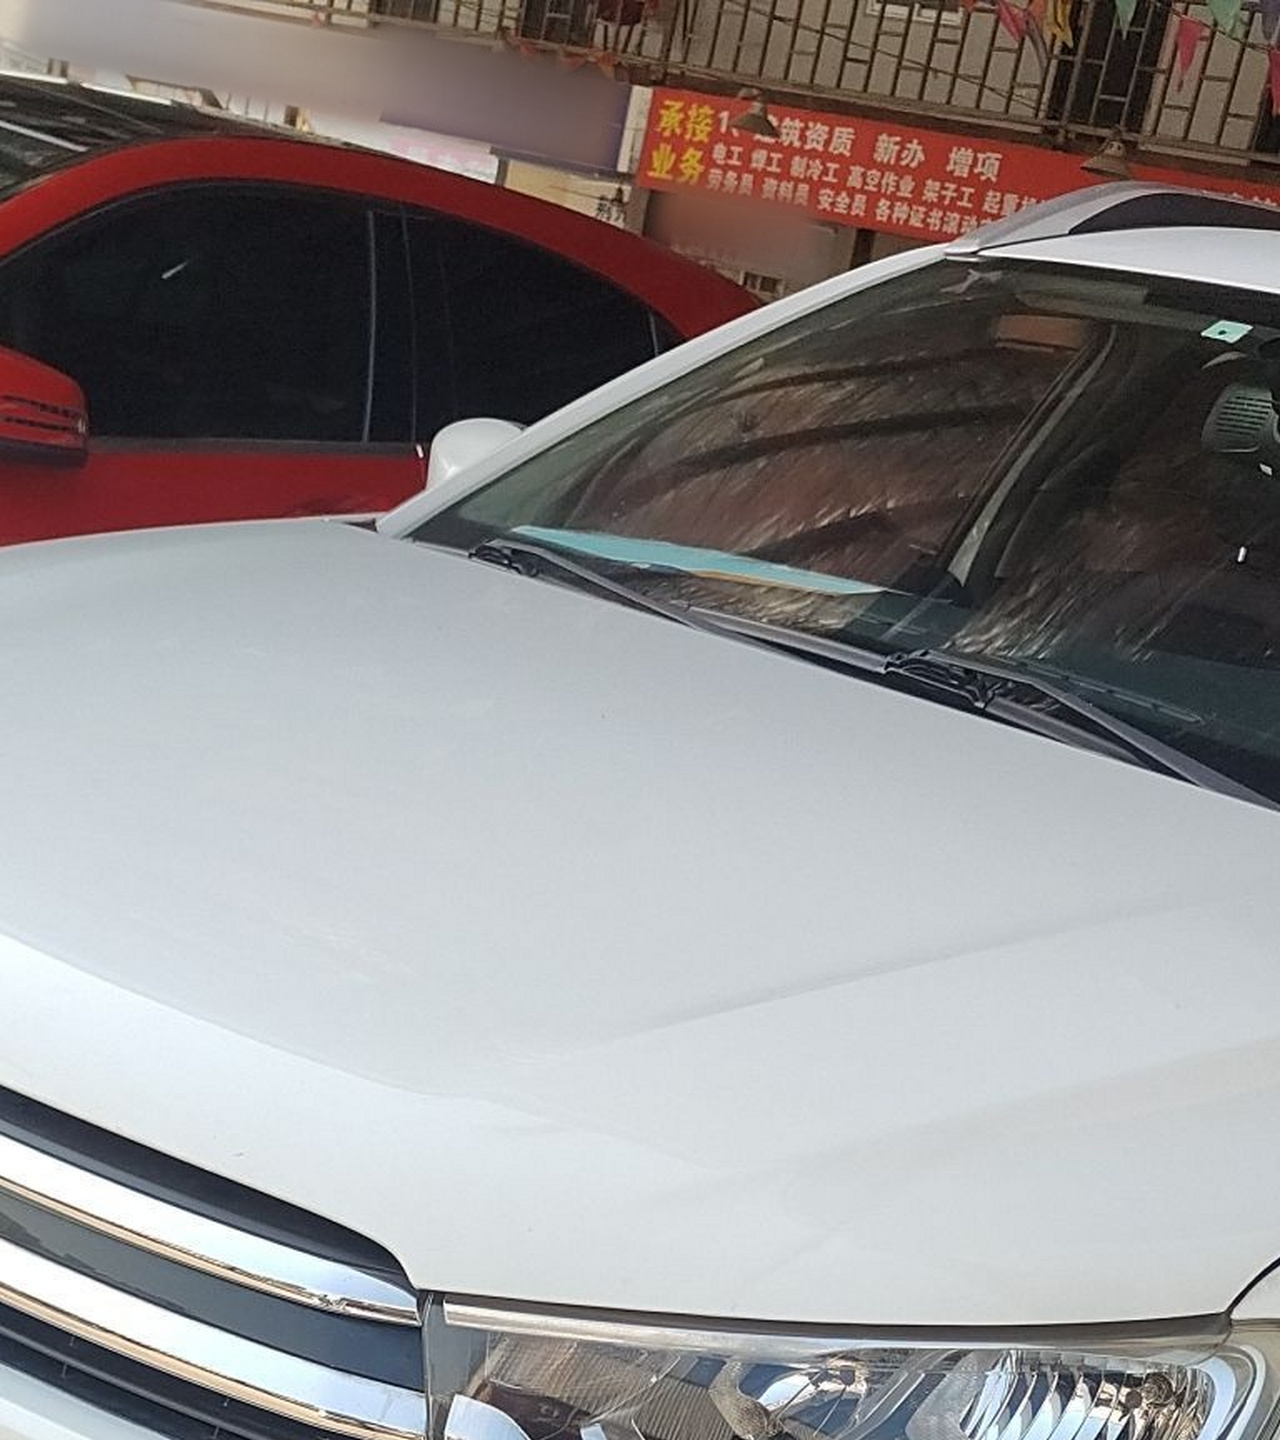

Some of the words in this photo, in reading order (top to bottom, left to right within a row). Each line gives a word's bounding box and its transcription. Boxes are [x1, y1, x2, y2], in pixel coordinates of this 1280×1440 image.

[656, 99, 716, 143] 承接
[647, 143, 705, 185] 业务
[873, 132, 925, 169] 新办
[946, 146, 1003, 183] 增项
[790, 155, 841, 184] 制冷工
[846, 165, 916, 199] 高空作业
[922, 179, 976, 209] 架子工
[817, 188, 868, 217] 安全员
